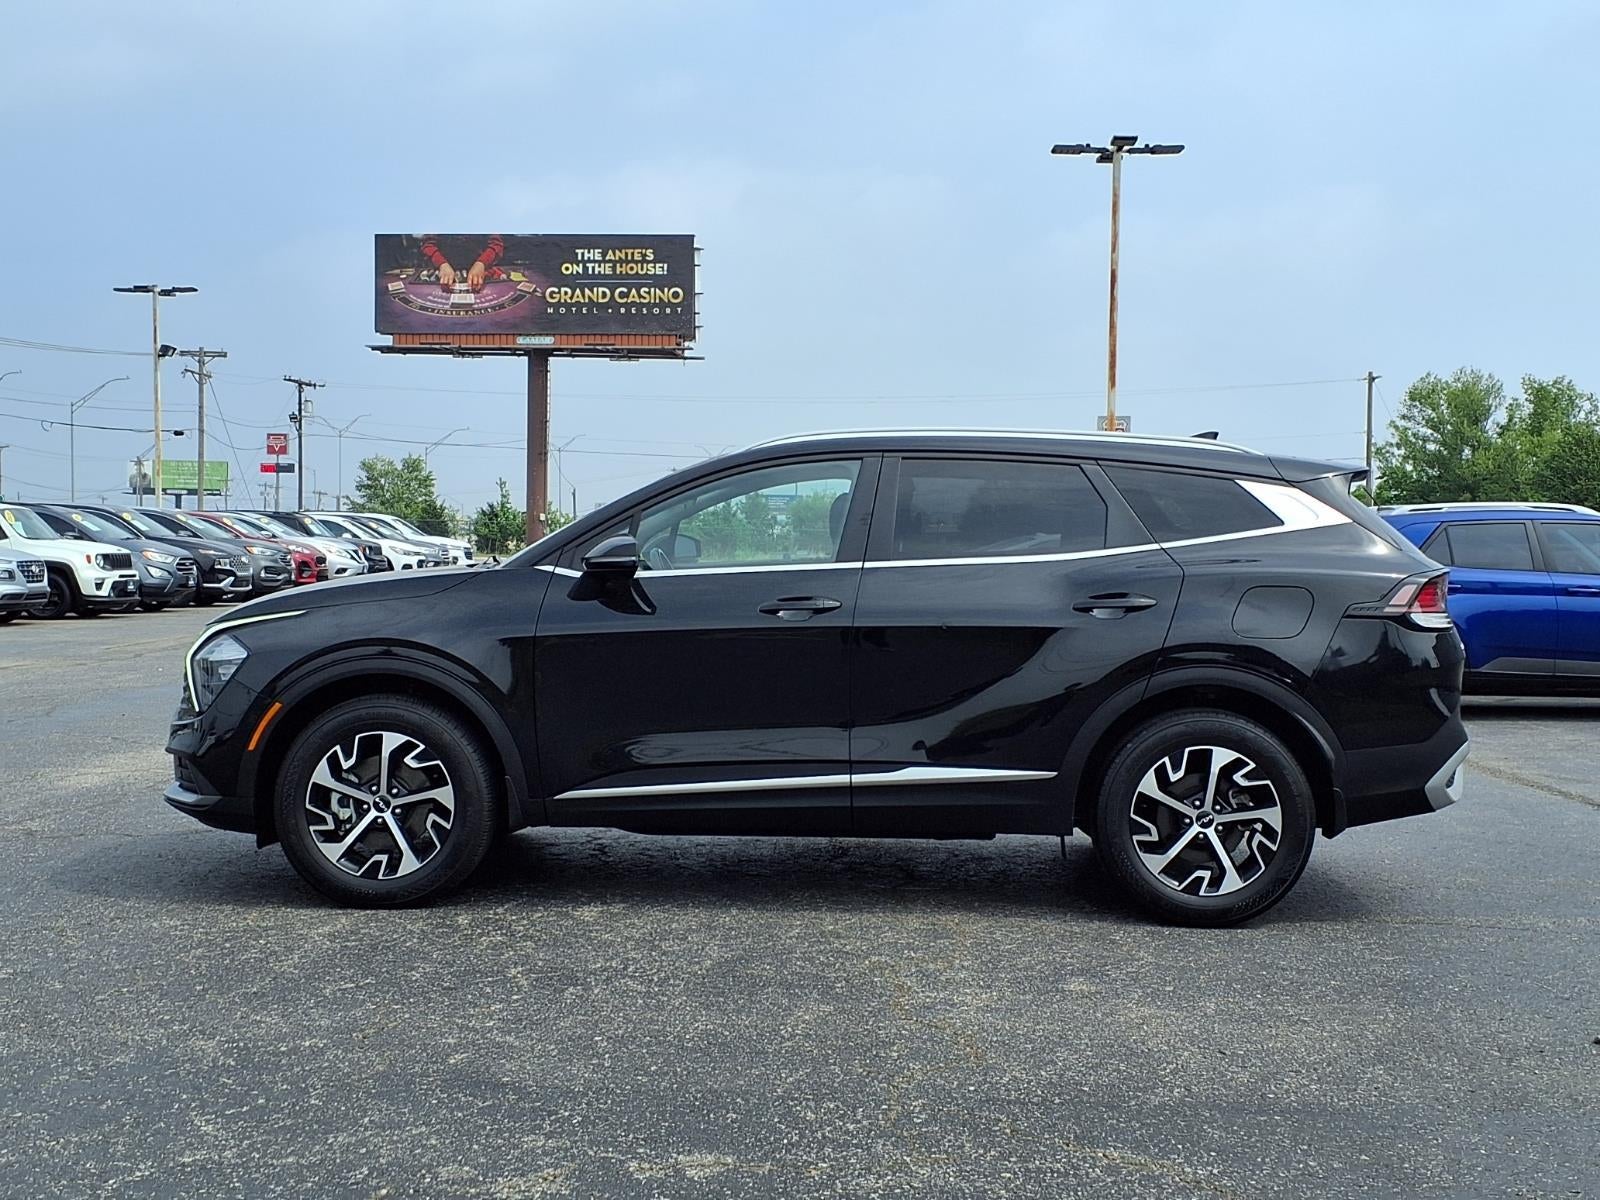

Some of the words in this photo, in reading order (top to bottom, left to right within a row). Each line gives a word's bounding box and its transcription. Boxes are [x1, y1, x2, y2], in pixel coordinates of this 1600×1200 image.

[575, 249, 603, 260] THE
[606, 249, 654, 261] ANTE'S
[561, 263, 582, 275] ON
[586, 263, 613, 275] THE
[616, 263, 668, 275] HOUSE!
[545, 287, 611, 303] GRAND
[614, 287, 684, 303] CASINO
